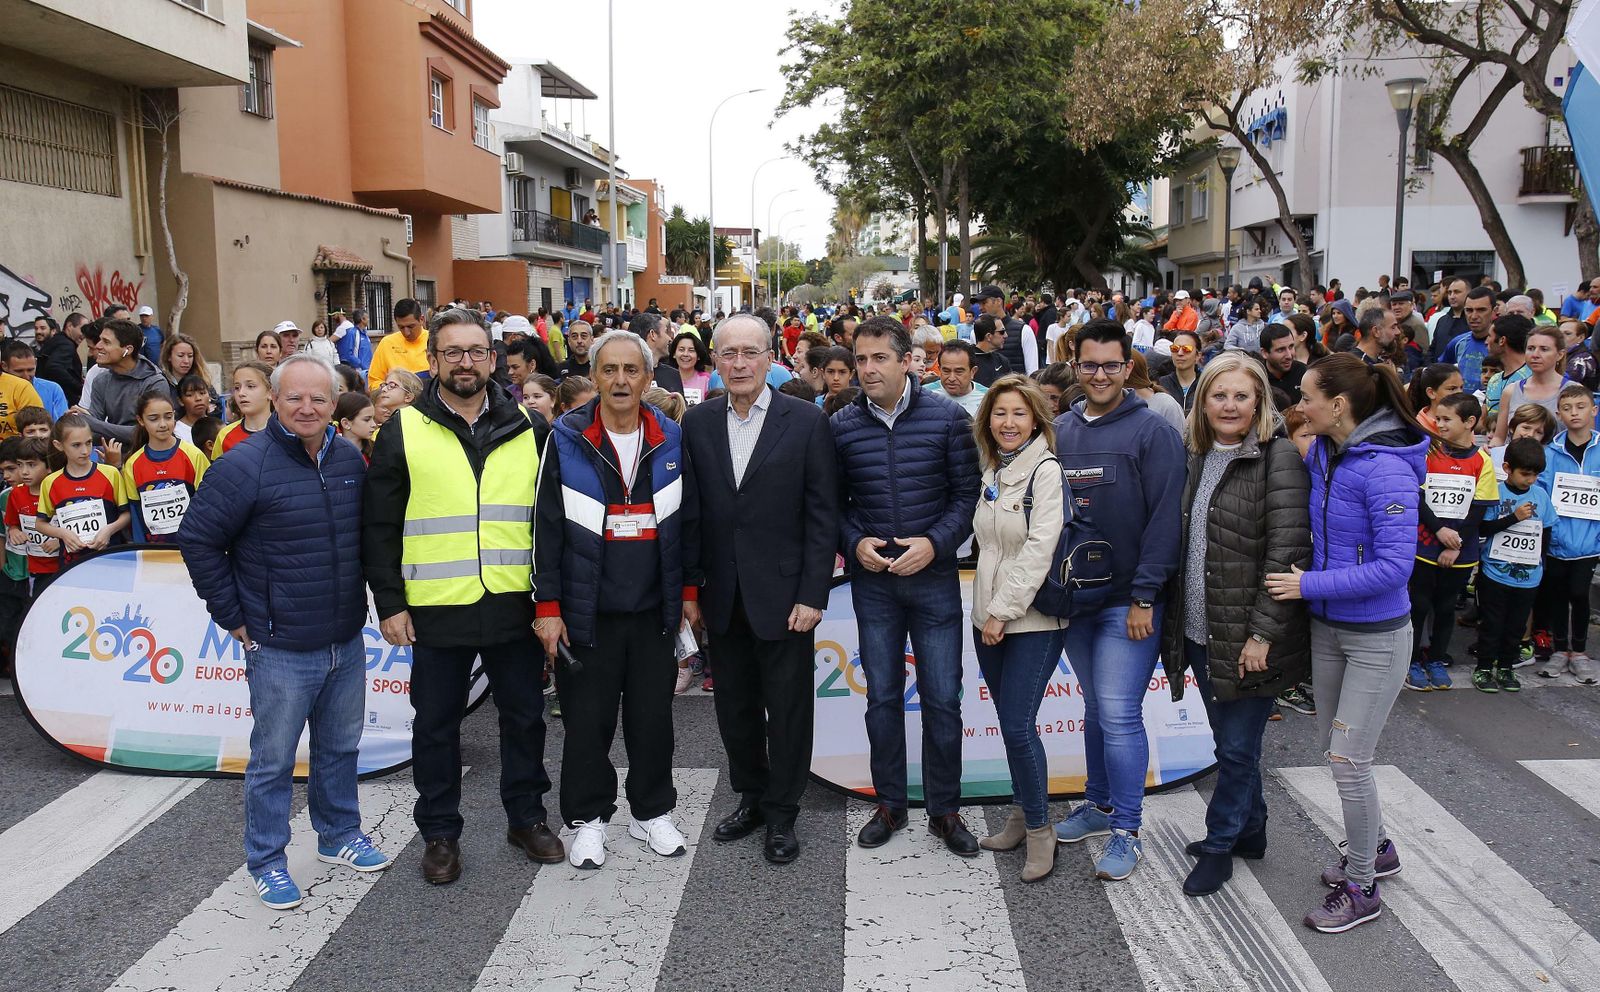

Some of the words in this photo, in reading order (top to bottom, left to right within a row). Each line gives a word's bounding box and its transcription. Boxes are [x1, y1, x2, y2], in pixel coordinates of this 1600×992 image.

[1432, 491, 1465, 505] 2139
[1561, 491, 1598, 506] 2186
[151, 504, 184, 521] 2152
[1502, 535, 1536, 551] 2093
[62, 606, 184, 684] 2020
